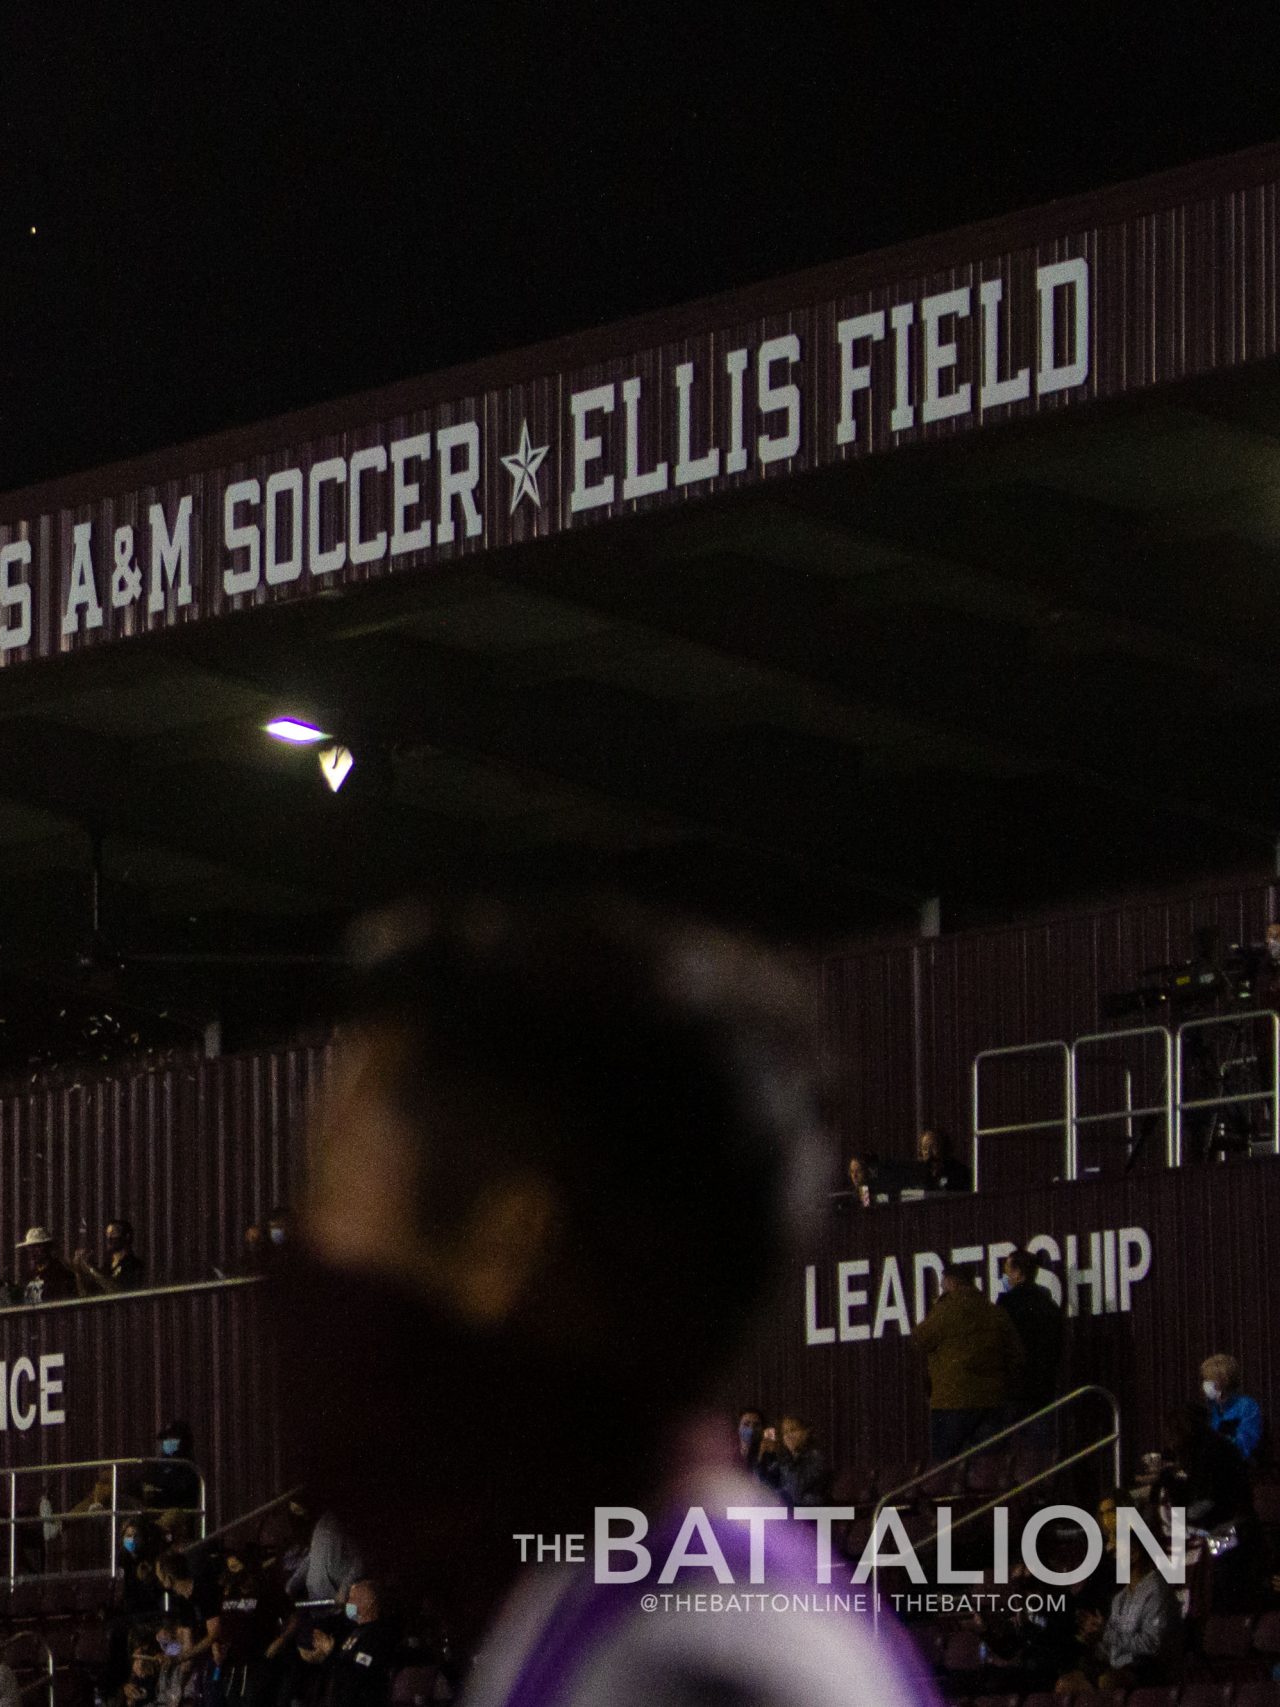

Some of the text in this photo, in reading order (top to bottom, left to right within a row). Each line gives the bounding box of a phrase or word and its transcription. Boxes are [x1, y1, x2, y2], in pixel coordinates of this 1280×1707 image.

[61, 496, 193, 634] A&M
[223, 421, 483, 596] SOCCER
[570, 334, 800, 513] ELLIS
[837, 257, 1090, 445] FIELD
